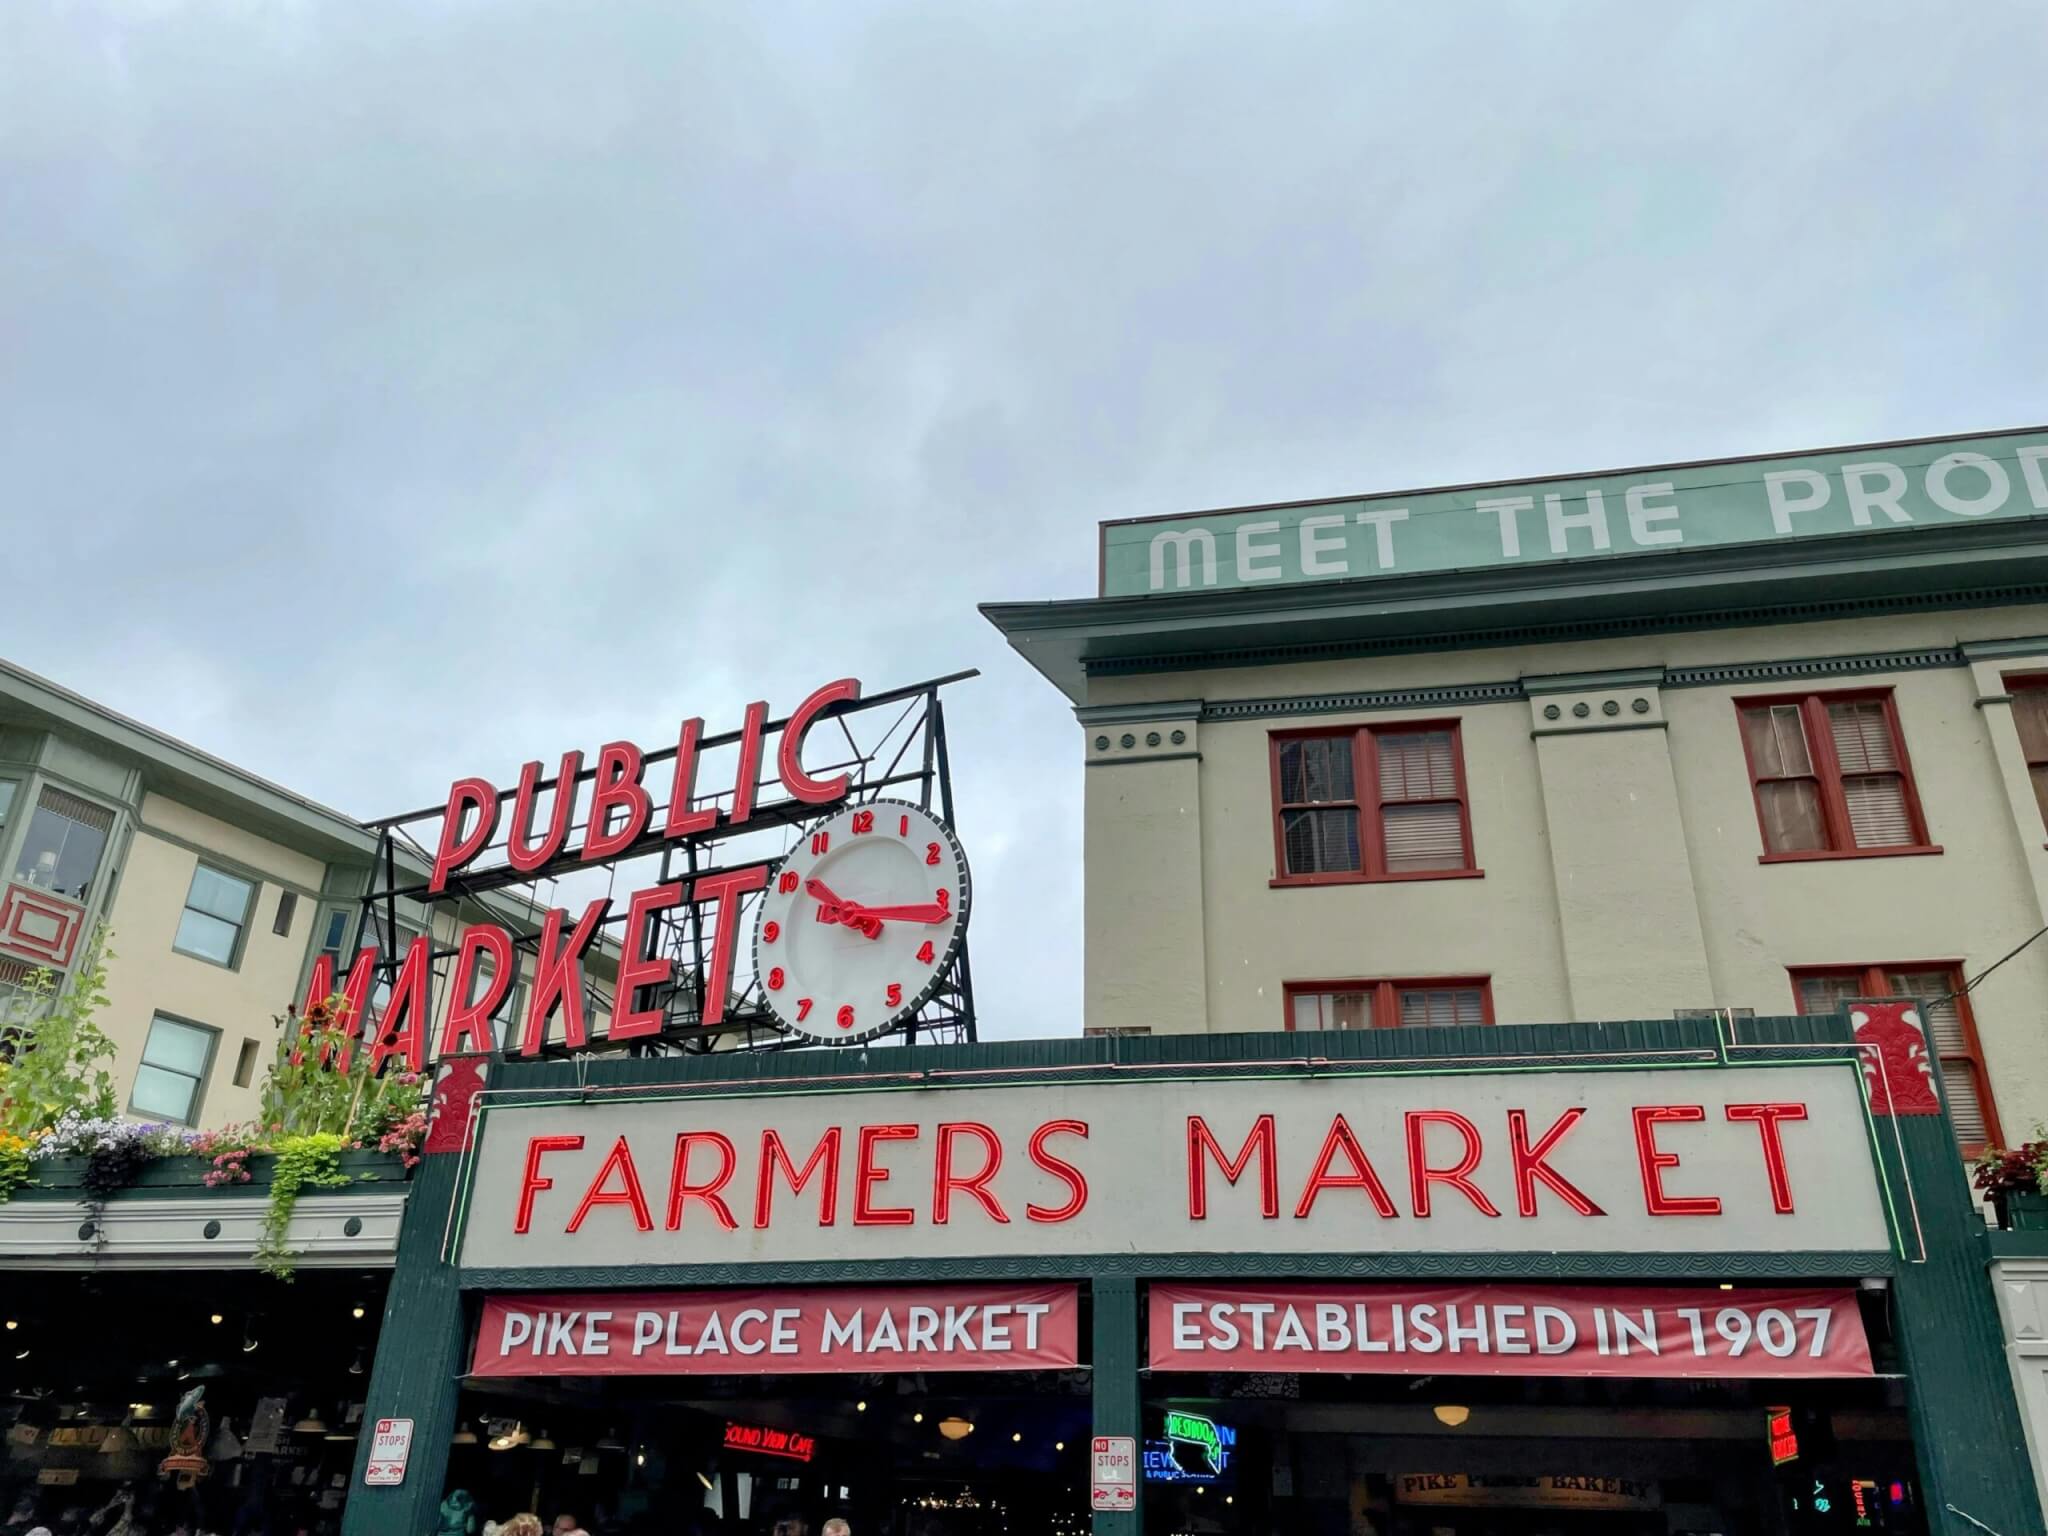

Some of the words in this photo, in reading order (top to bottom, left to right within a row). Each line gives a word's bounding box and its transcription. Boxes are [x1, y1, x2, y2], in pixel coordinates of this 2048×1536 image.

[1148, 508, 1411, 591] MEET
[1475, 481, 1684, 558] THE
[428, 678, 861, 893] PUBLIC
[852, 810, 874, 834] 12
[899, 815, 909, 837] 1
[811, 831, 829, 856] 11
[926, 842, 941, 865] 2
[778, 871, 799, 894] 10
[763, 921, 780, 944] 9
[916, 940, 935, 965] 4
[290, 864, 769, 1075] MARKET
[767, 967, 785, 991] 8
[885, 983, 902, 1008] 5
[796, 998, 813, 1022] 7
[836, 1005, 855, 1029] 6
[514, 1119, 1090, 1234] FARMERS
[1186, 1102, 1809, 1220] MARKET
[499, 1311, 613, 1357] PIKE
[632, 1307, 800, 1356] PLACE
[819, 1303, 1049, 1354] MARKET
[1171, 1303, 1577, 1356] ESTABLISHED
[1597, 1307, 1661, 1358] IN
[1684, 1308, 1833, 1359] 1907
[378, 1422, 390, 1432] NO
[724, 1421, 761, 1446] SOUND
[762, 1427, 788, 1450] VIEW
[378, 1435, 407, 1447] STOPS
[1094, 1440, 1107, 1451] NO
[1097, 1455, 1129, 1466] STOPS
[1403, 1473, 1457, 1492] PIKE
[1551, 1475, 1648, 1499] BAKERY
